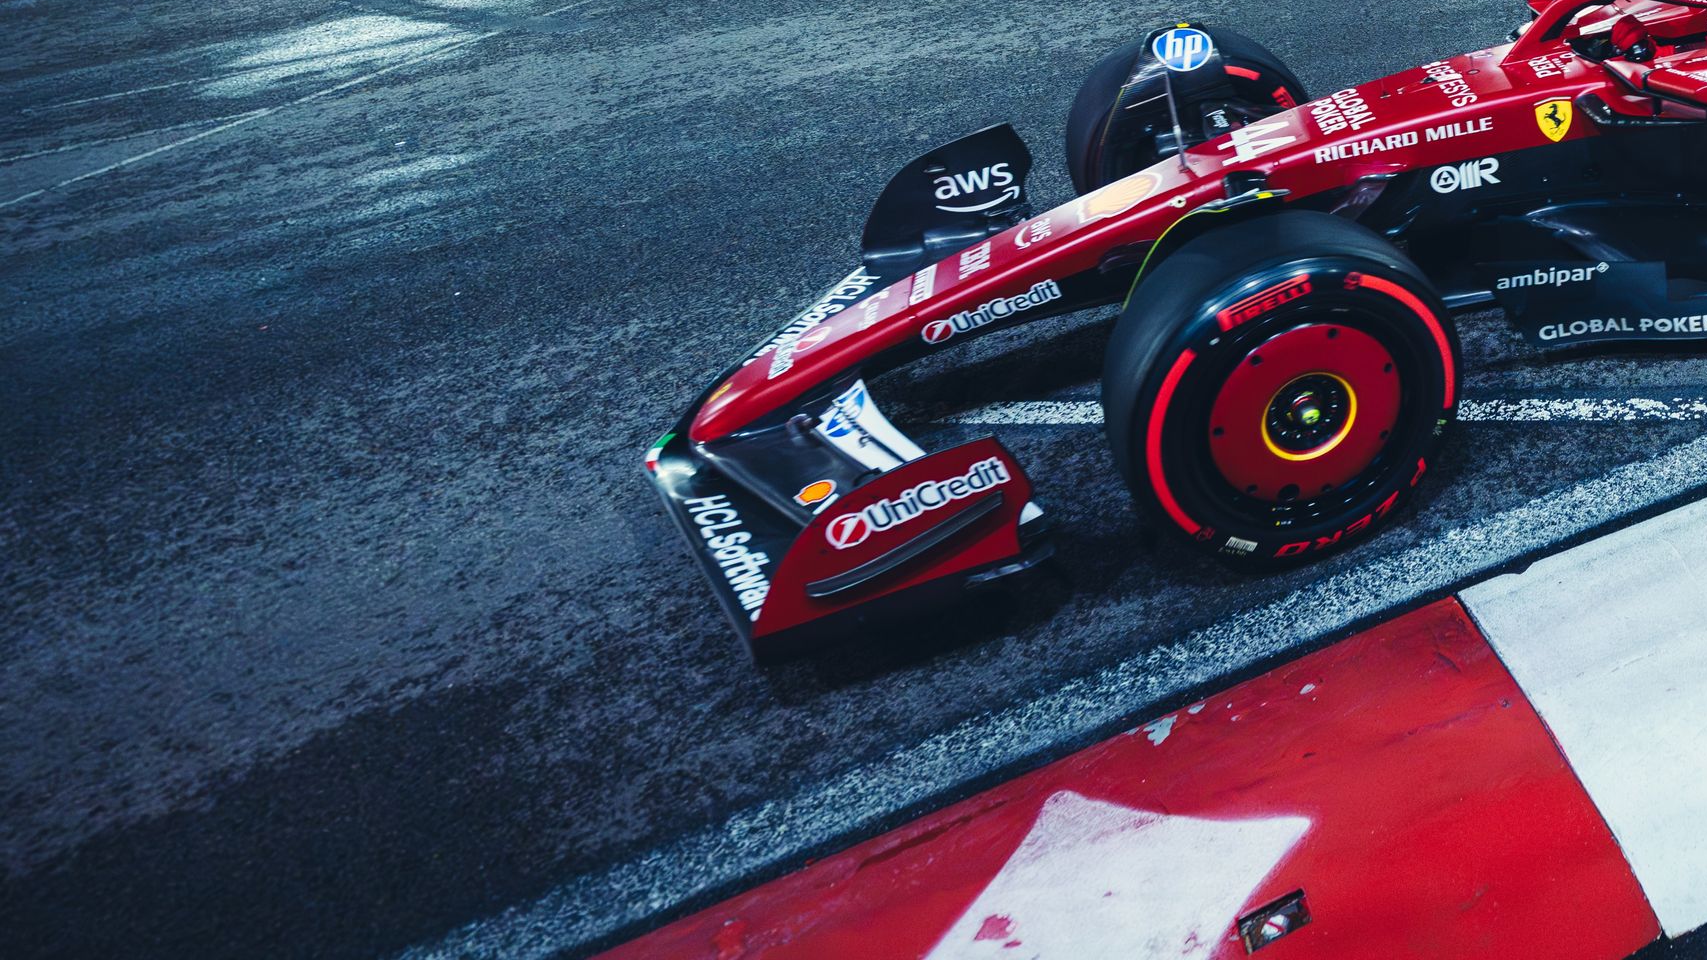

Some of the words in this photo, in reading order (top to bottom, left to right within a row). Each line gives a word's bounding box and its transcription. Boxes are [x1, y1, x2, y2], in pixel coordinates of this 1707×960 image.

[1161, 28, 1205, 70] hp
[1307, 98, 1349, 136] POKER
[1331, 88, 1377, 131] GLOBAL
[1315, 131, 1419, 165] RICHARD
[1425, 116, 1494, 142] MILLE
[933, 162, 1014, 201] aws
[1496, 264, 1597, 290] ambipar
[951, 278, 1062, 332] UniCredit
[1538, 317, 1634, 340] GLOBAL
[866, 457, 1012, 533] UniCredit
